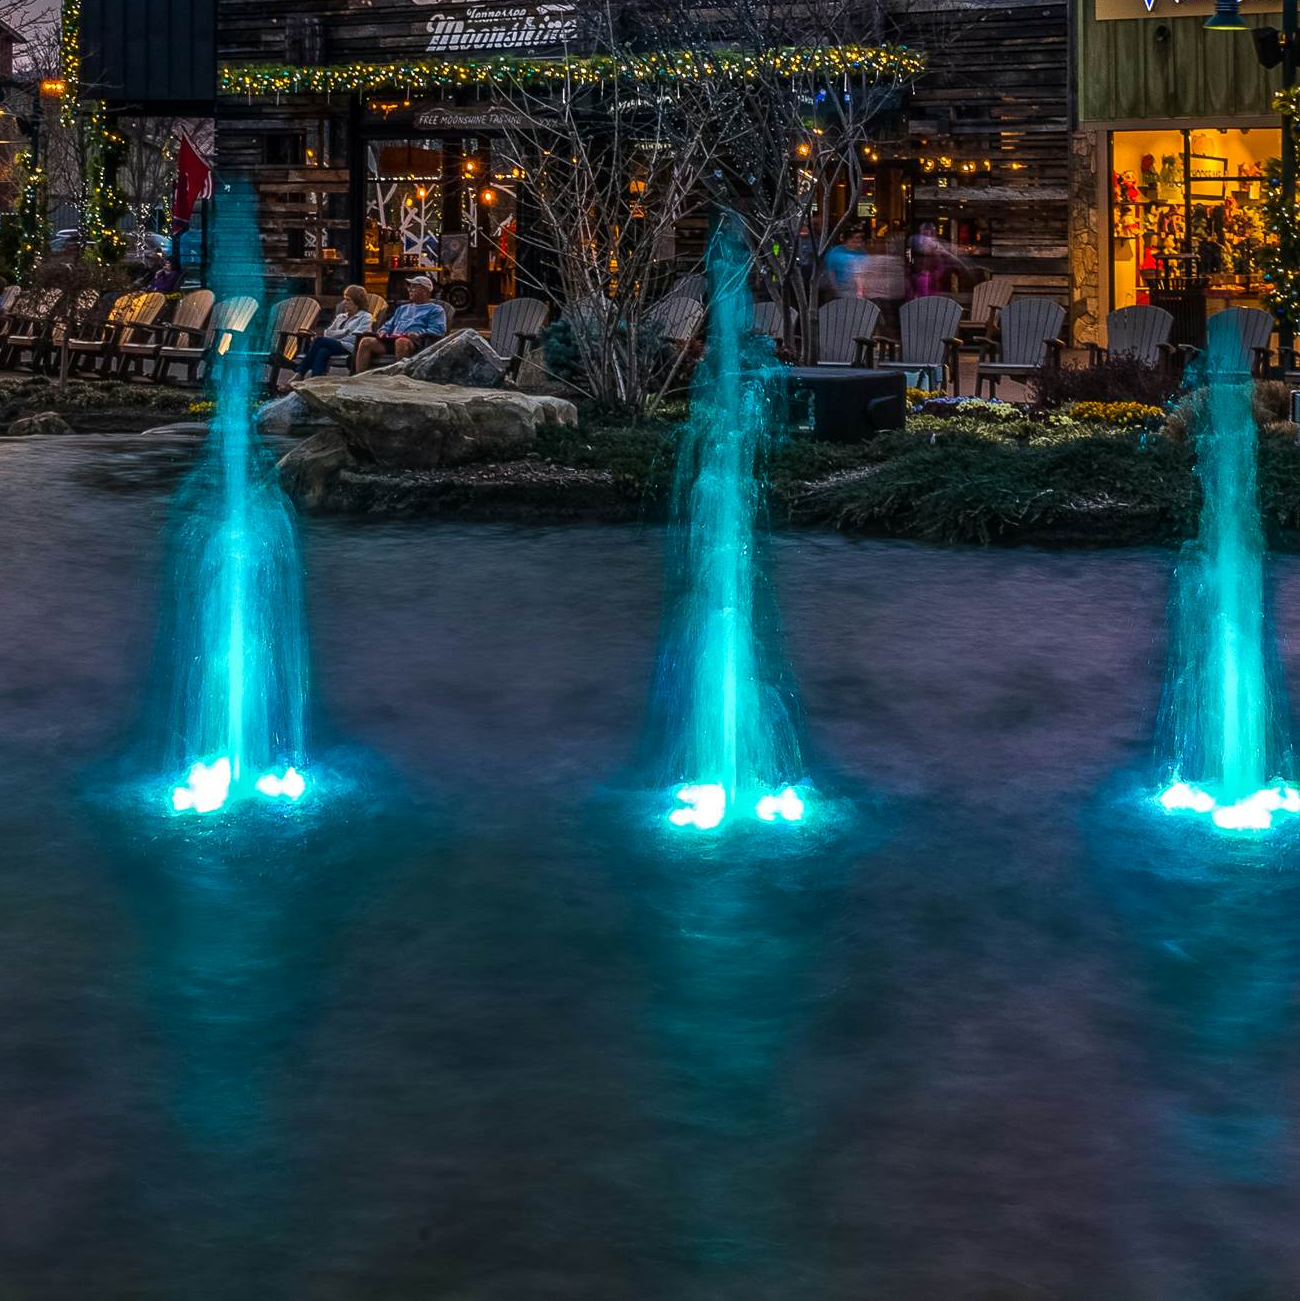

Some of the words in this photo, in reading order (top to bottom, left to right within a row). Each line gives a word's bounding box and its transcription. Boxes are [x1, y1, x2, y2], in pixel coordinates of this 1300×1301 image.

[466, 3, 527, 23] Tennessee
[425, 13, 579, 53] Moonshine
[418, 113, 438, 126] FREE
[440, 112, 487, 125] MOONSHINE
